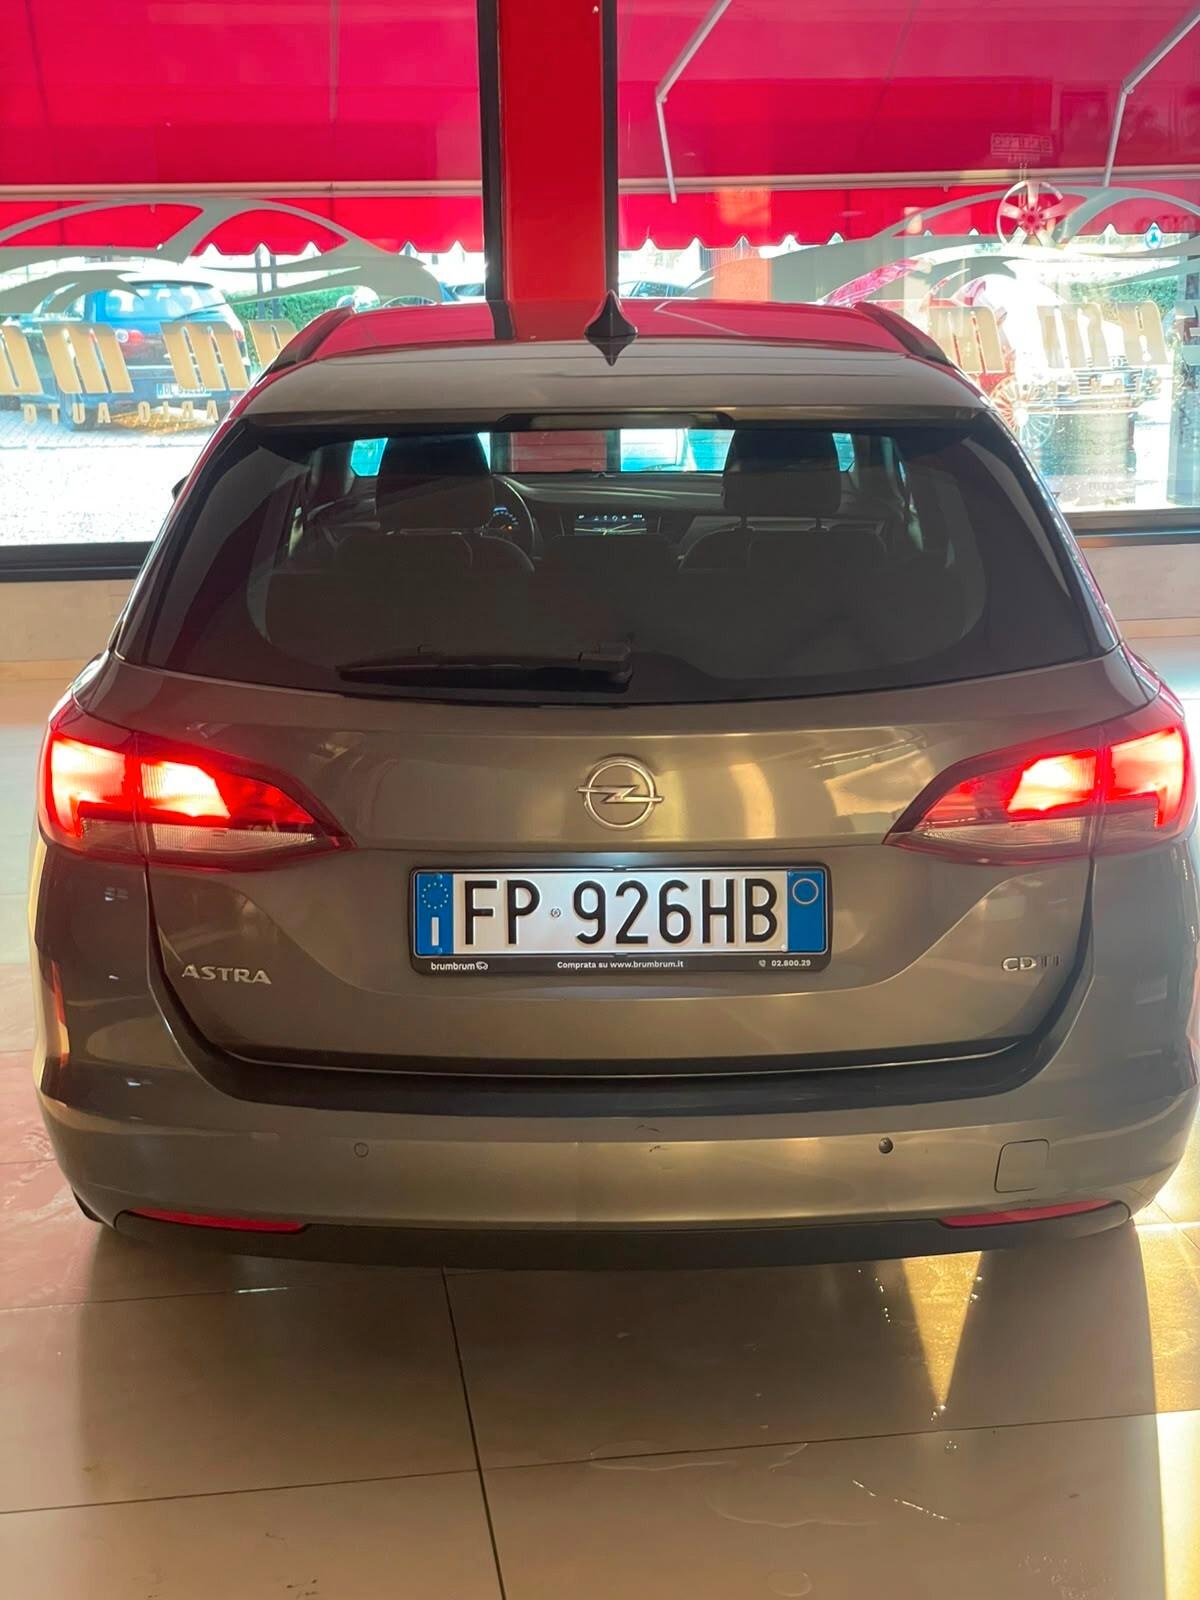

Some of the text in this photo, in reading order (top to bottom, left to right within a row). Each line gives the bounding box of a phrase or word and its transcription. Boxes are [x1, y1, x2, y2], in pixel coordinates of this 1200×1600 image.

[464, 880, 541, 945] FP
[573, 878, 778, 945] 926HB
[430, 961, 476, 971] brumbrum
[557, 959, 684, 971] Comprata su www.brumbrum.it
[182, 963, 272, 985] ASTRA
